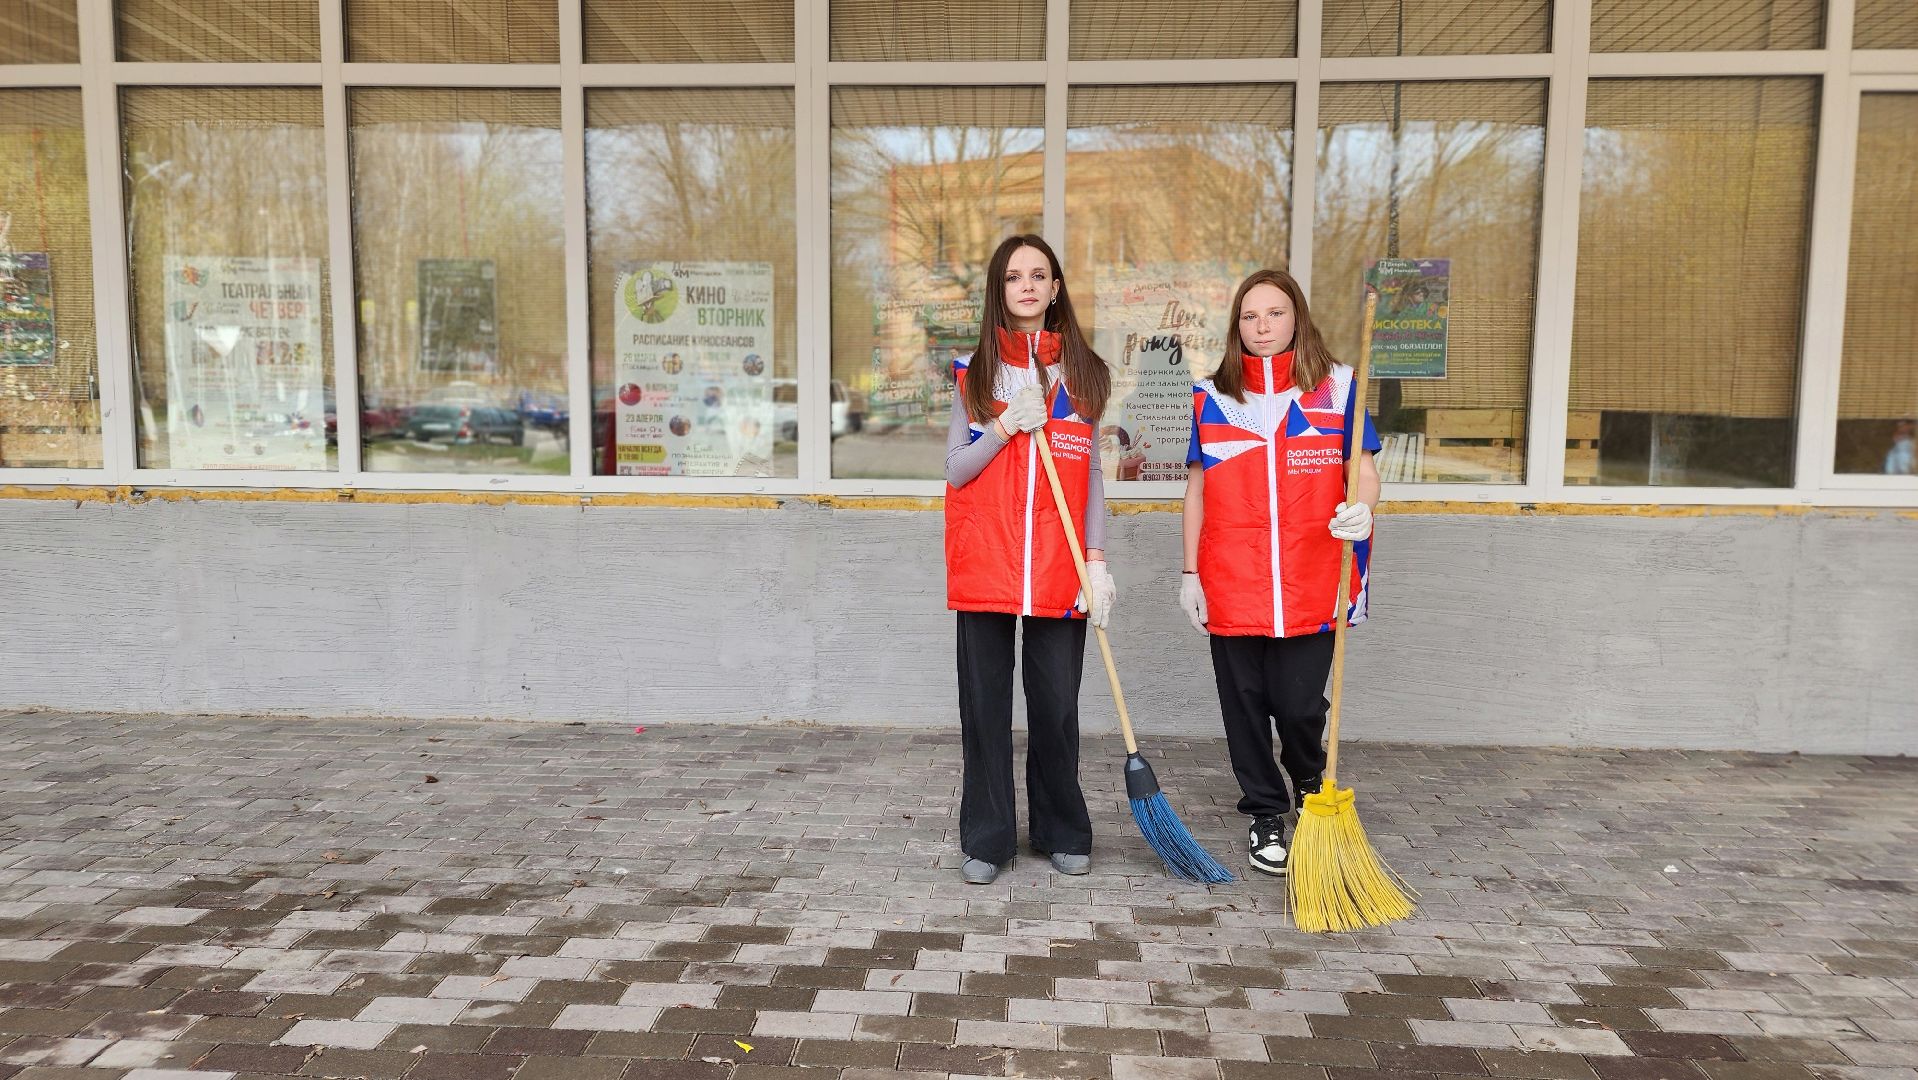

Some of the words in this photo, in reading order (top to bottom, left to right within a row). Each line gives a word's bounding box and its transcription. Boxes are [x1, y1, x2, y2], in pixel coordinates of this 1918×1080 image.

[686, 286, 726, 305] КИНО
[697, 308, 766, 327] ВТОРНИК
[932, 307, 984, 321] ФИЗРУК
[1157, 300, 1207, 330] День
[1374, 319, 1443, 330] ИСКОТЕКА
[633, 334, 692, 346] РАСПИСАНИЕ
[1370, 344, 1398, 352] ресс-код
[1127, 368, 1174, 376] Вечеринки
[1175, 368, 1191, 376] для
[1126, 402, 1188, 410] Качественный
[1135, 413, 1176, 421] Стильная
[1051, 431, 1093, 447] ВОЛОНТЕ
